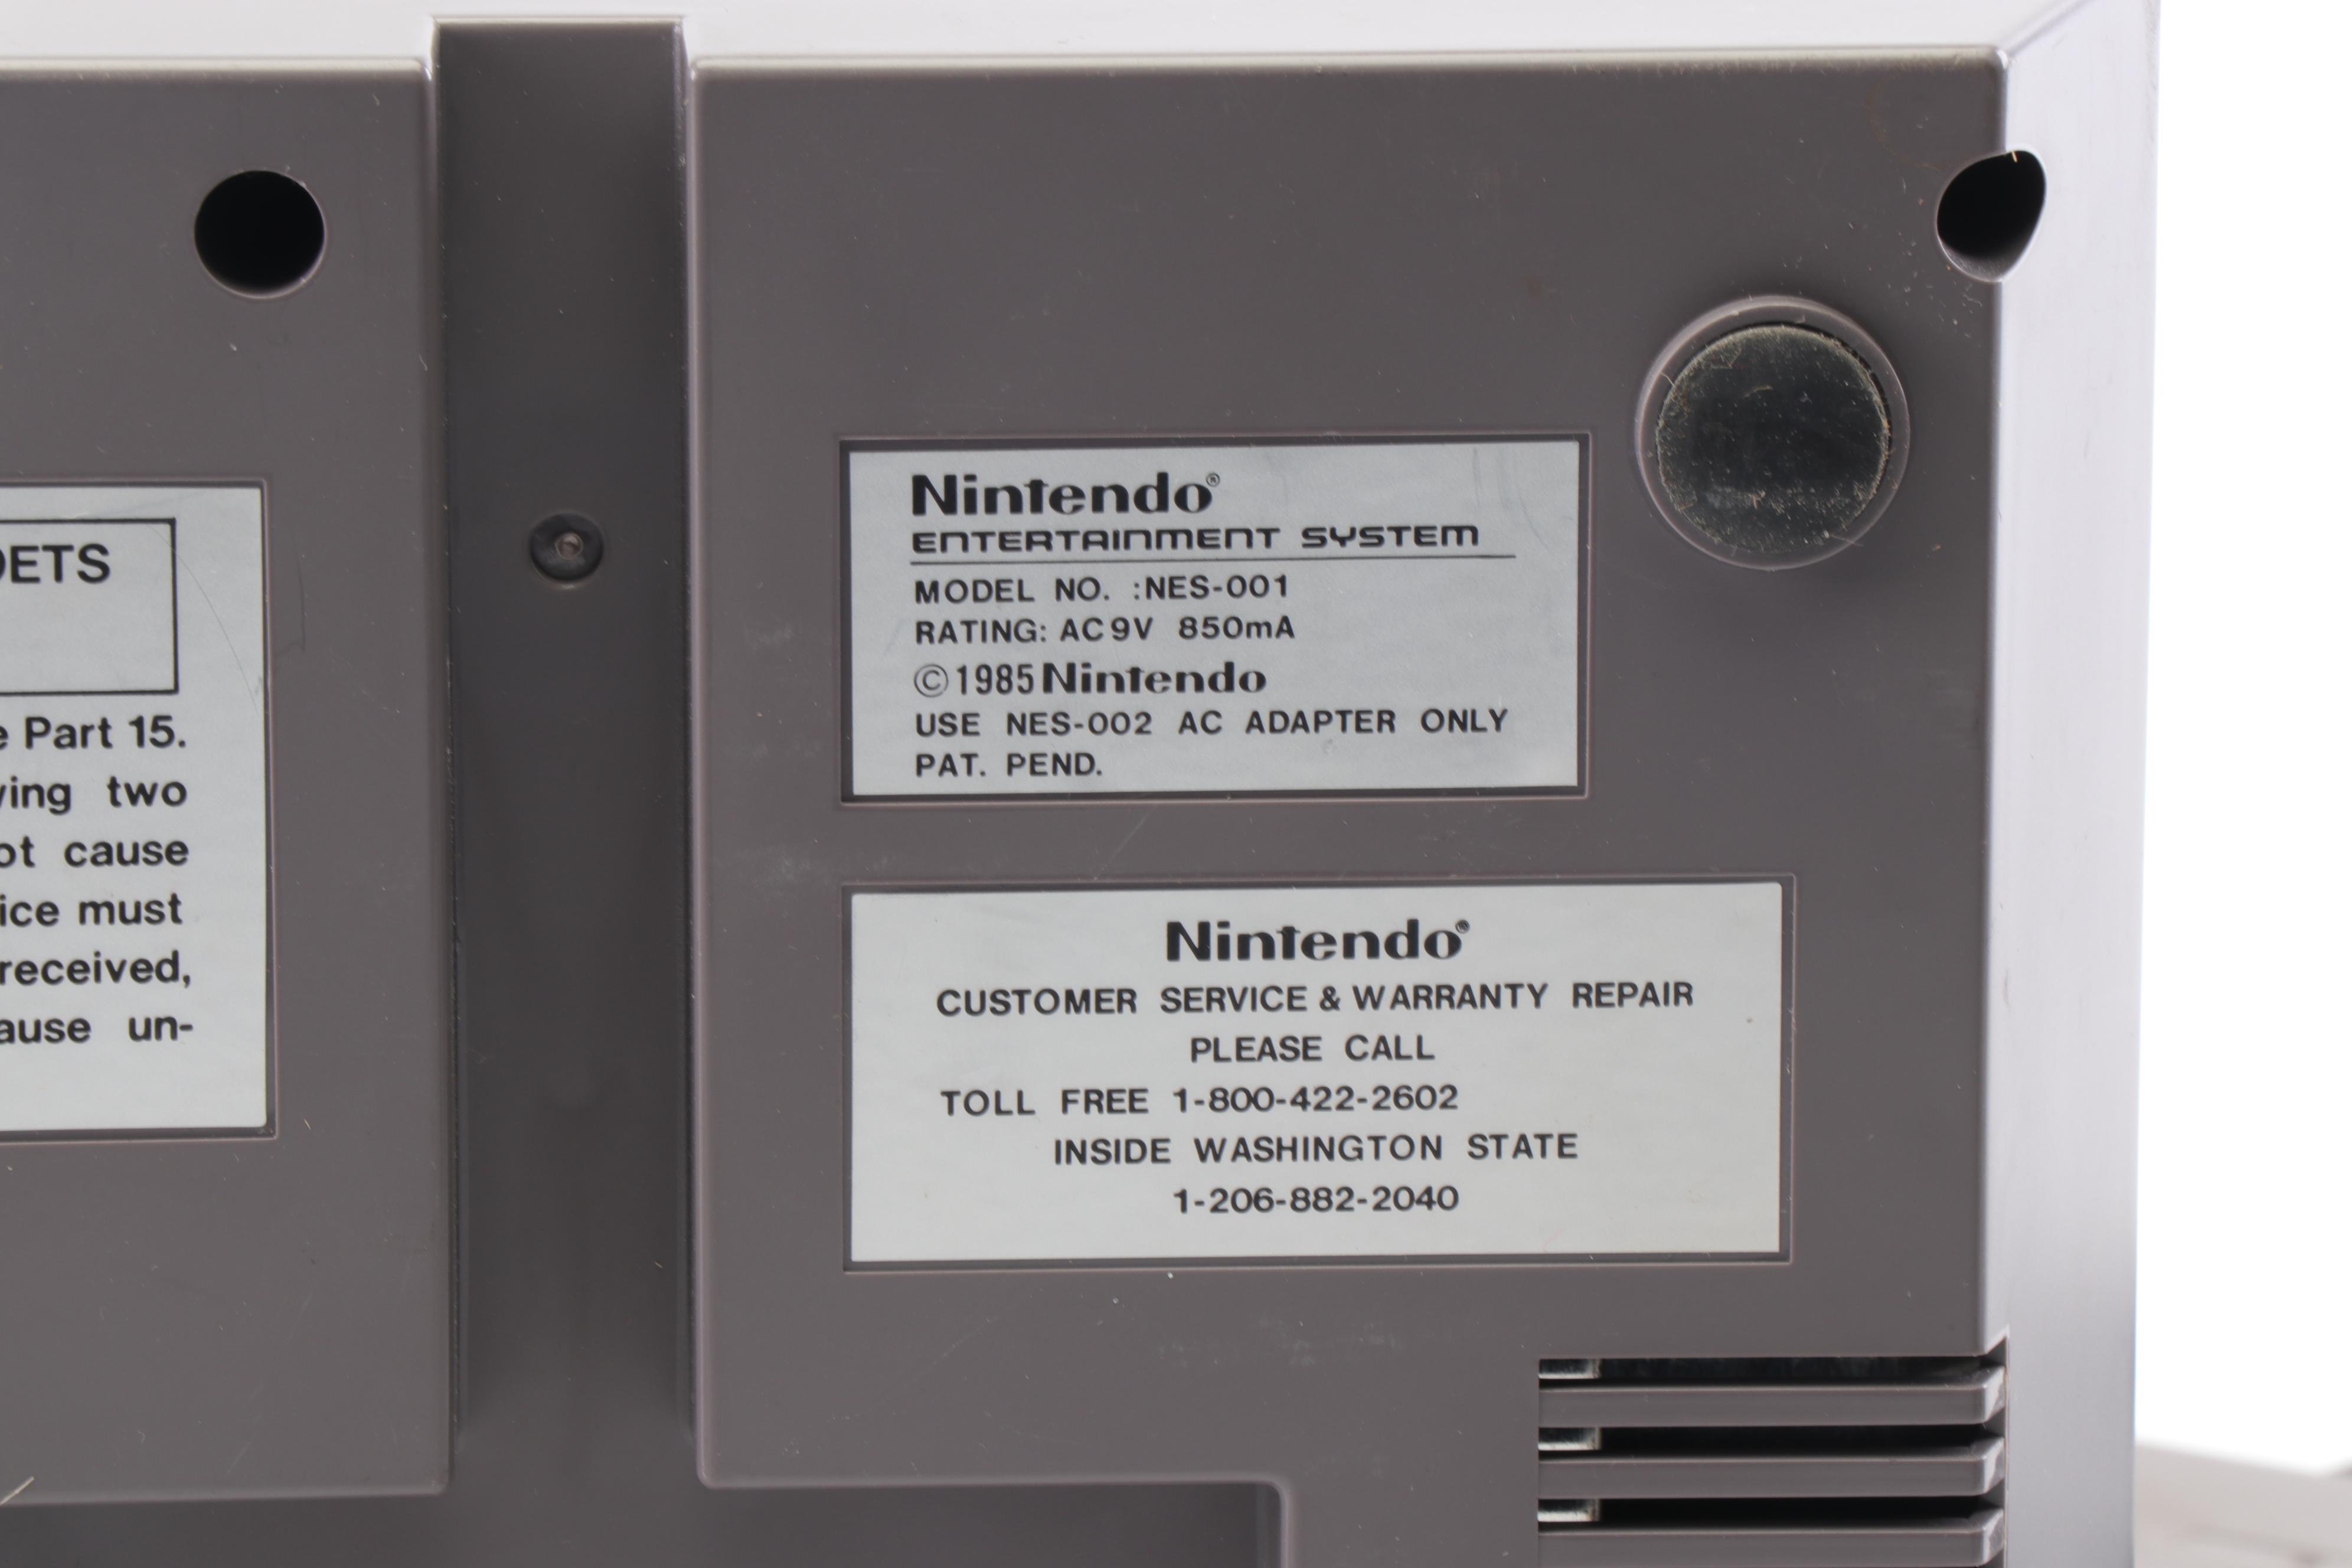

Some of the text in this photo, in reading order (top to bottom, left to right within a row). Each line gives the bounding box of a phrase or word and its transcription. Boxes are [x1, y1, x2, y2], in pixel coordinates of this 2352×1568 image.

[912, 525, 1479, 554] ENTERTAINMENT SYSTEM
[0, 543, 111, 584] ETS
[914, 578, 1035, 604] MODEL
[1055, 576, 1109, 602] NO.
[916, 618, 1046, 645] RATING:
[1178, 615, 1295, 640] 850mA
[1043, 661, 1267, 694] Nintendo
[25, 716, 113, 750] Part
[128, 714, 186, 749] 15.
[916, 708, 1508, 737] USE NES-002 AC ADAPTER ONLY
[916, 752, 1102, 778] PAT. PEND.
[106, 776, 187, 808] two
[64, 840, 189, 868] cause
[79, 892, 183, 926] must
[0, 949, 191, 988] received,
[936, 981, 1693, 1017] CUSTOMER SERVICE & WARRANTY REPAIR
[128, 1015, 194, 1042] un-
[1191, 1034, 1435, 1063] PLEASE CALL
[940, 1084, 1458, 1117] TOLL FREE 1-800-422-2602
[1054, 1133, 1578, 1165] INSIDE WASHINGTON STATE
[1174, 1185, 1459, 1214] 1-206-882-2040
